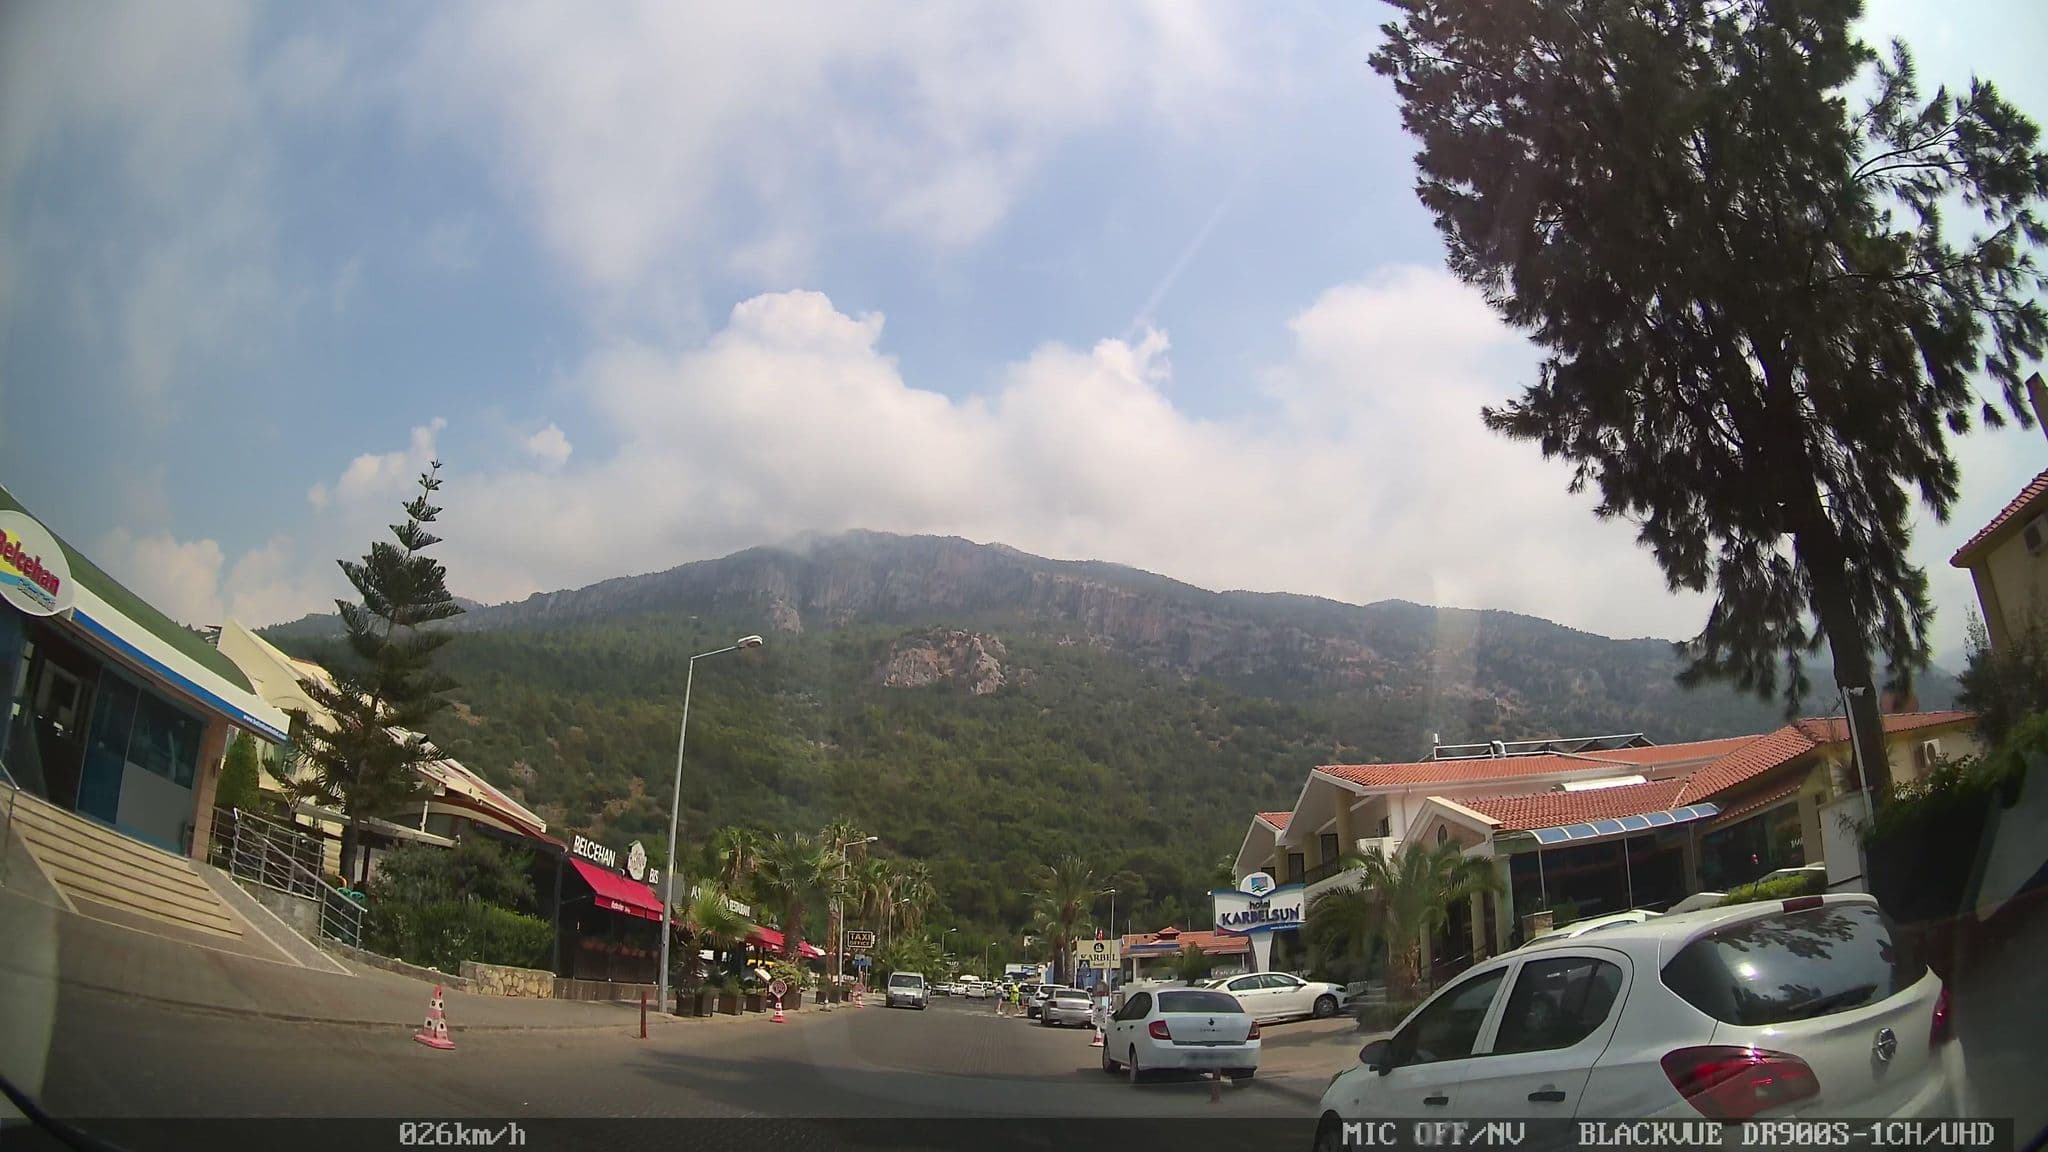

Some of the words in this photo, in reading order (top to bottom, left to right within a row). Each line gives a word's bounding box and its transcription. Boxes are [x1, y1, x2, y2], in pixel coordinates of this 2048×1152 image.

[573, 835, 616, 868] BELCEHAN
[1249, 899, 1271, 910] hotel
[1221, 903, 1301, 926] KARBELSUN
[849, 933, 871, 941] TAXI
